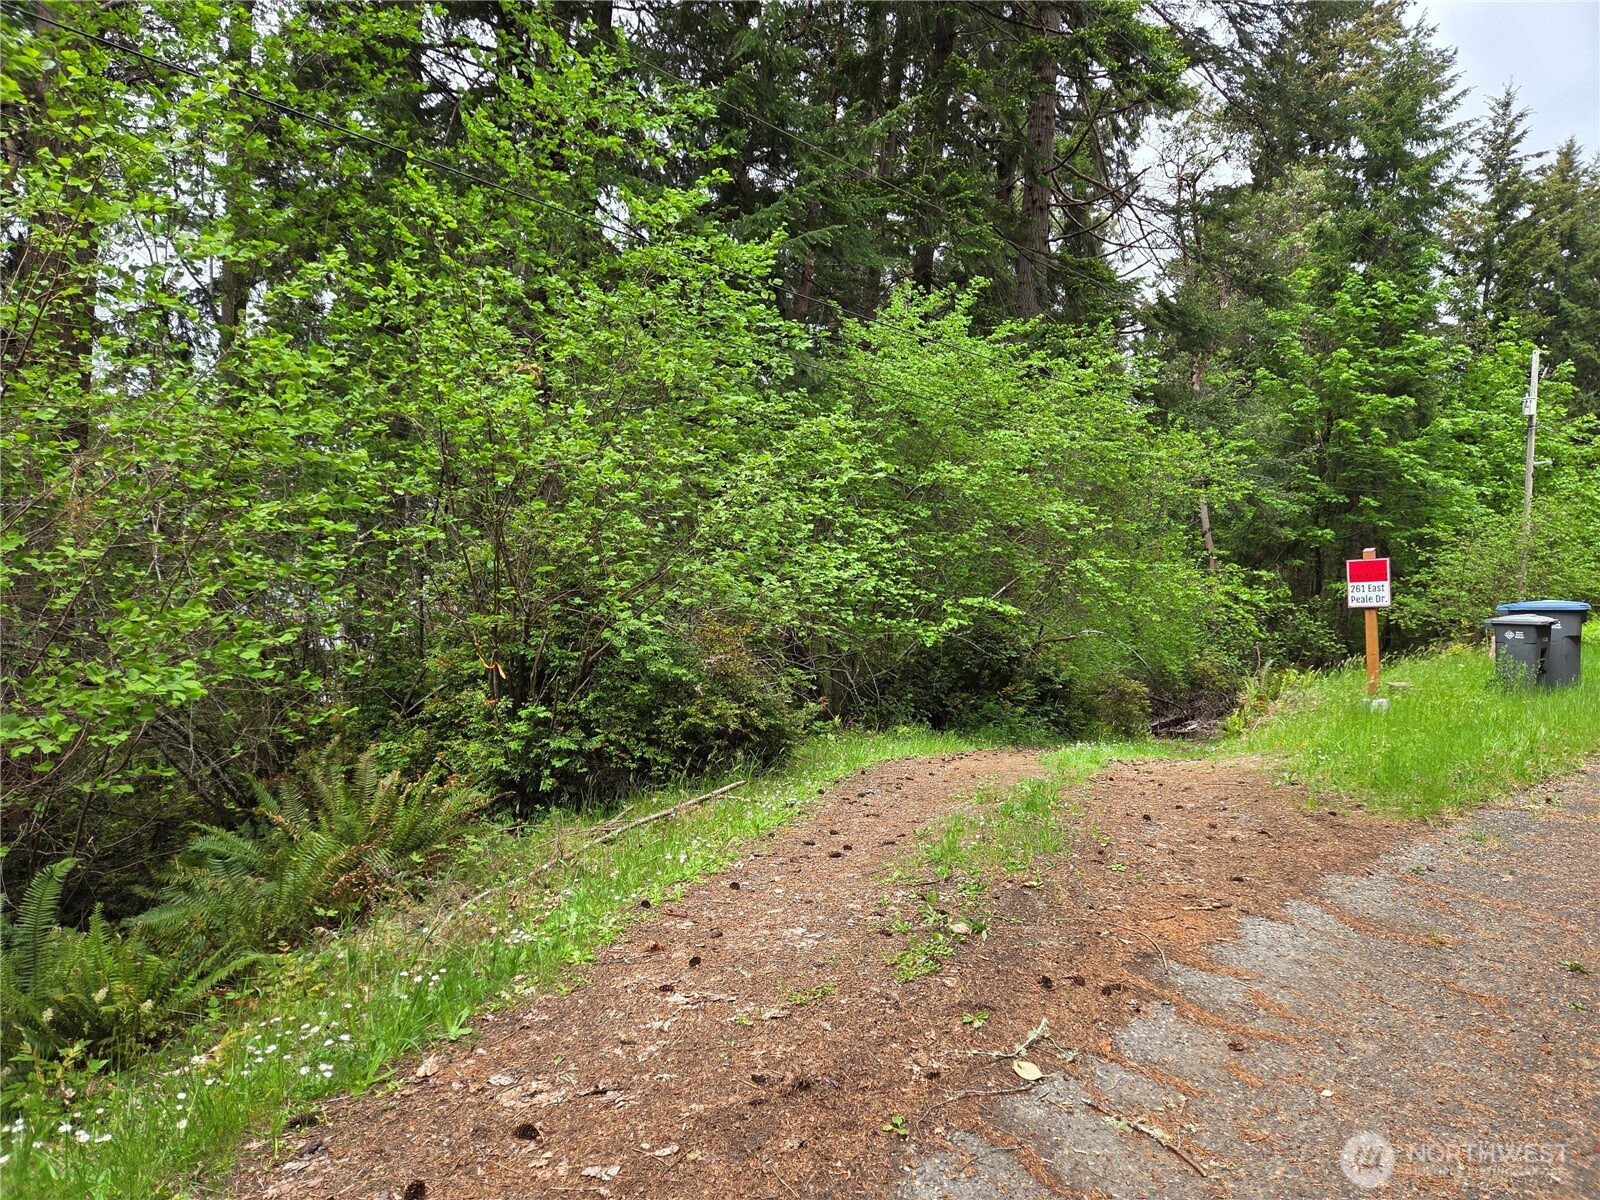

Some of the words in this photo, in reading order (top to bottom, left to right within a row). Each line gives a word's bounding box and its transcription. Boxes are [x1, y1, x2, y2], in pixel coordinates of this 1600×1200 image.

[1350, 584, 1366, 593] 261
[1368, 584, 1385, 592] East
[1350, 594, 1373, 603] Peale
[1375, 595, 1388, 603] Dr.
